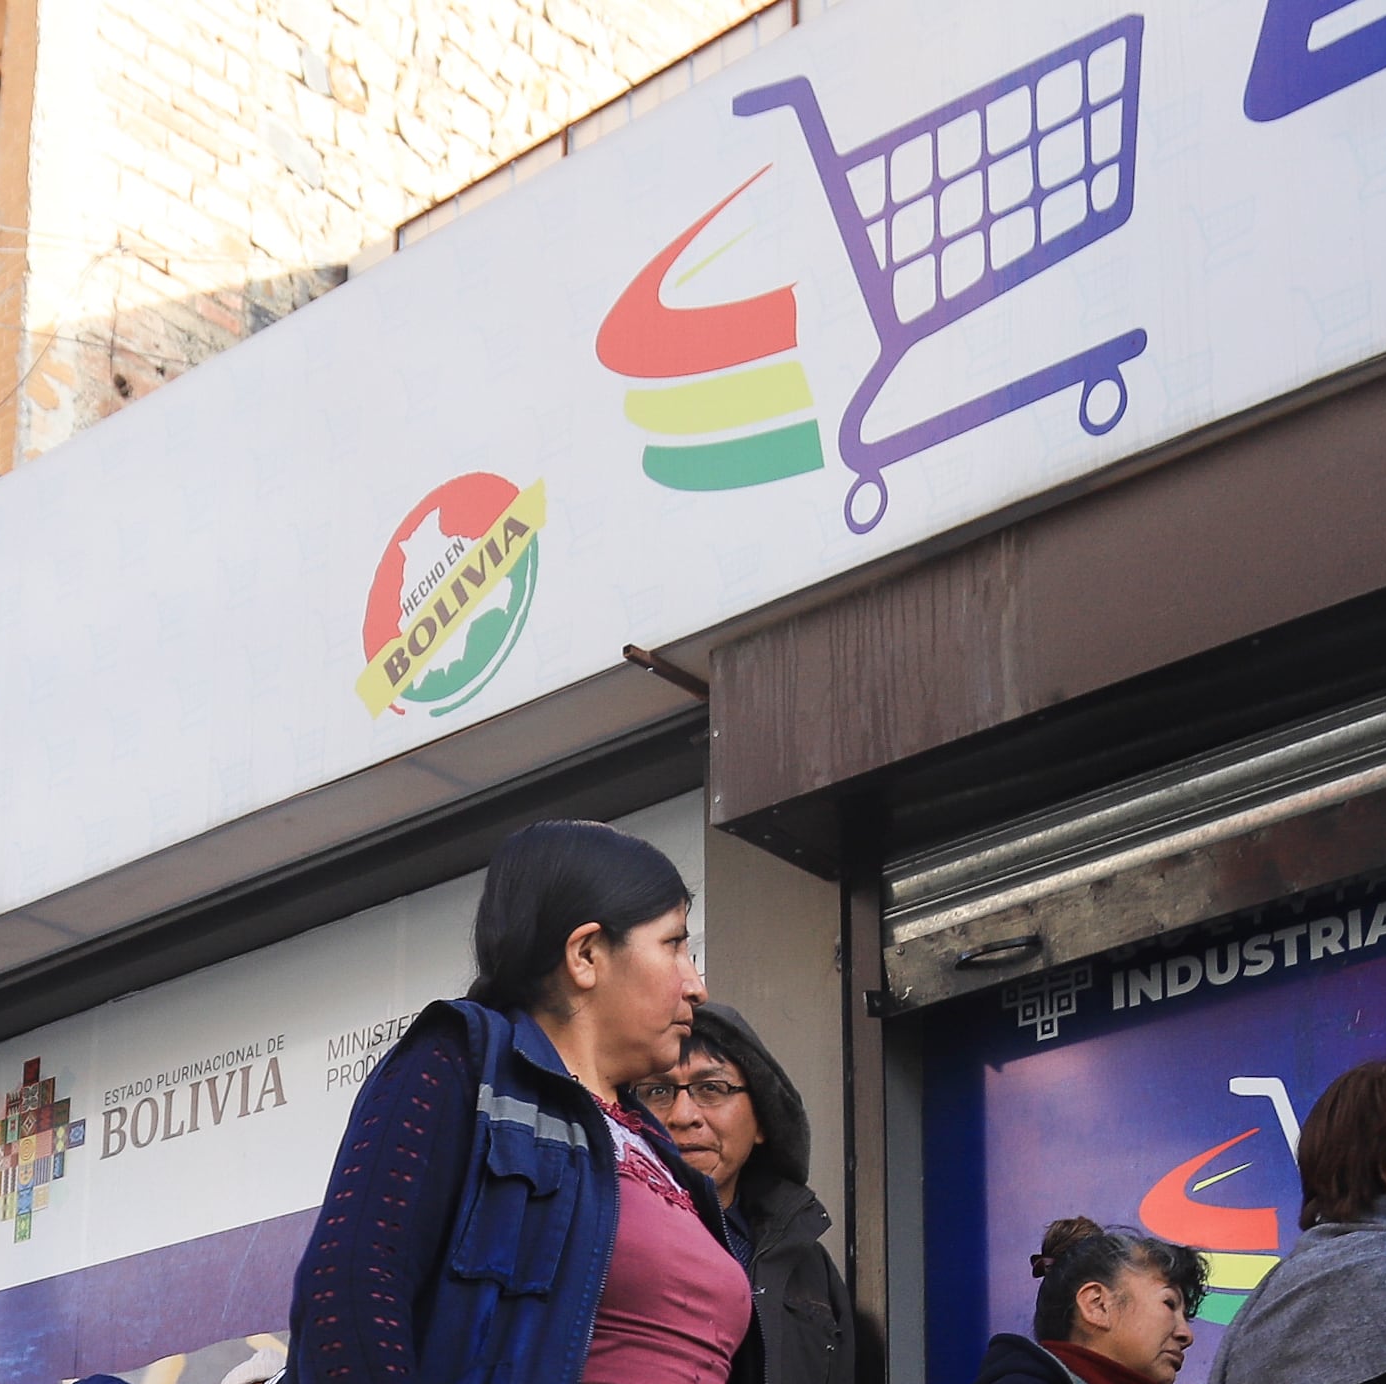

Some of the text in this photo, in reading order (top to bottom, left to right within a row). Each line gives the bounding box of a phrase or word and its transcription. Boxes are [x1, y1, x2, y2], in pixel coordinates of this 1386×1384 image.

[383, 515, 530, 687] BOLIVIA
[402, 537, 466, 617] HECHO EN
[99, 1056, 288, 1161] BOLIVIA
[104, 1034, 285, 1106] ESTADO PLURINACIONAL DE
[326, 1051, 382, 1092] PROD
